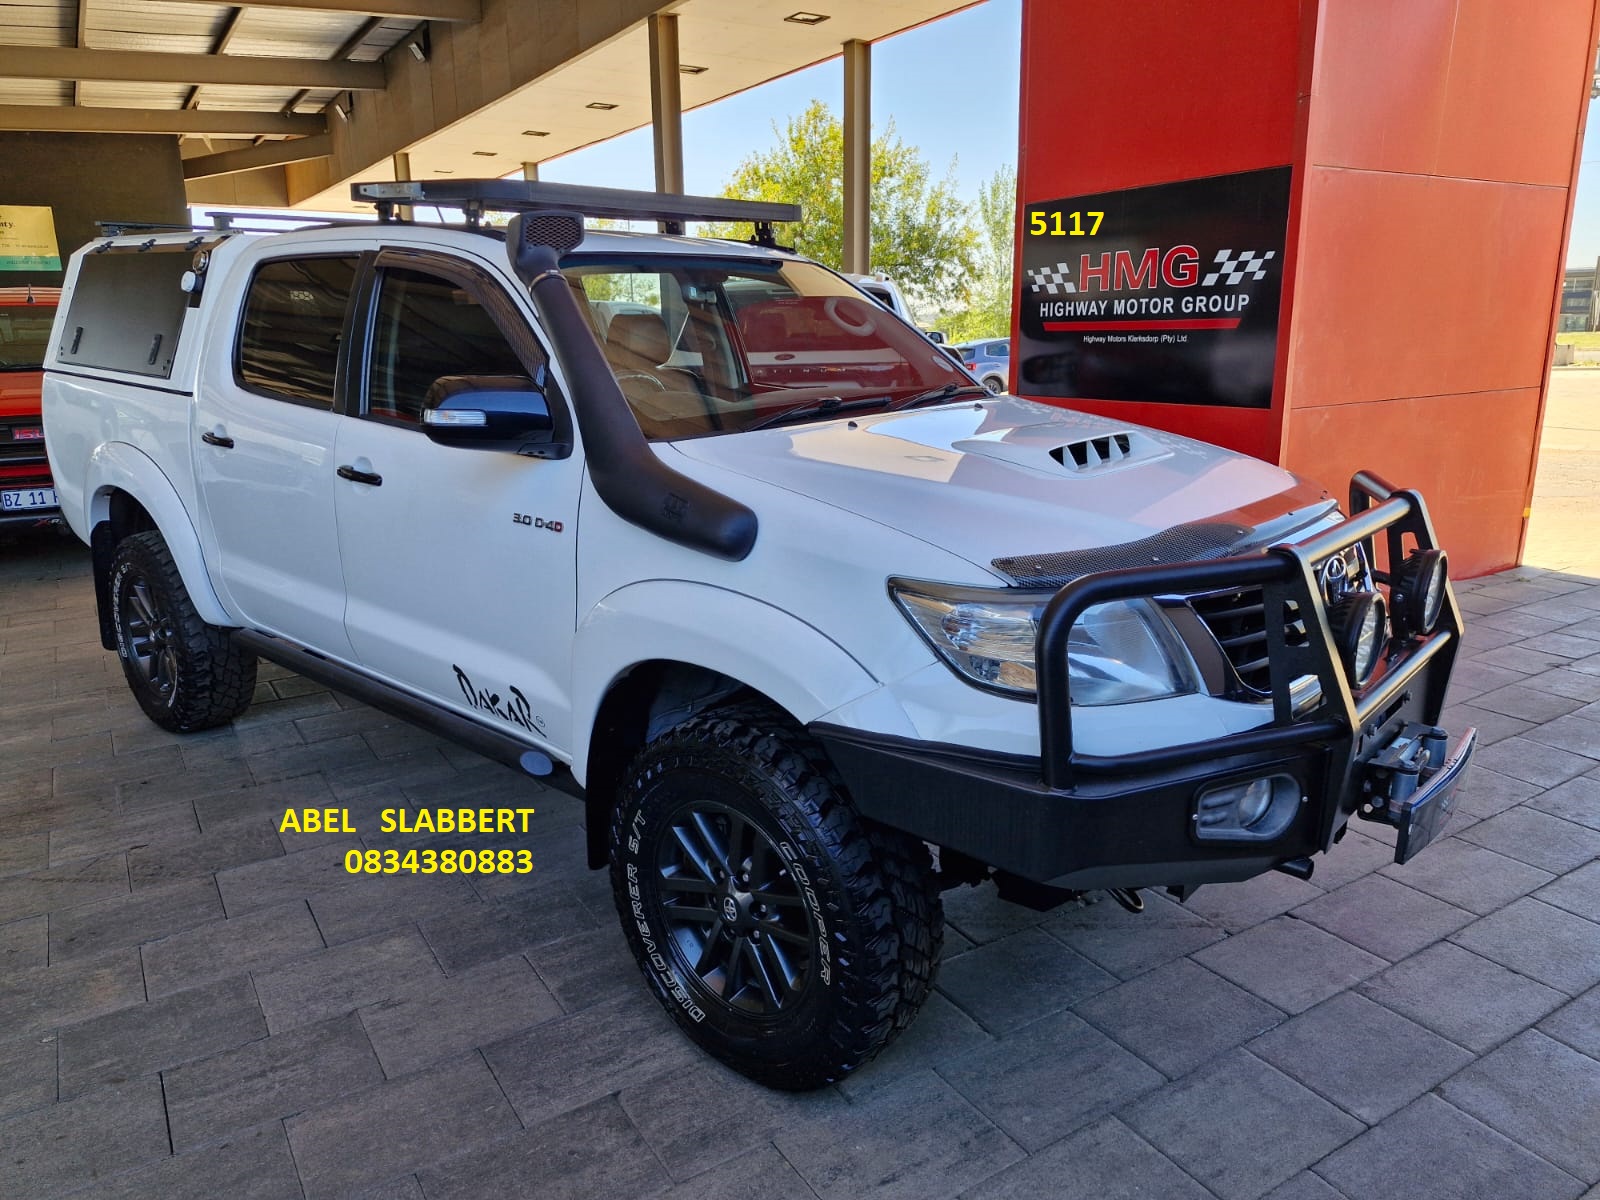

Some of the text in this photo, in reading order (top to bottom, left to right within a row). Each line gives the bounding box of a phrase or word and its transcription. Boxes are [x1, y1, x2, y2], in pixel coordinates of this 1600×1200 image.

[1079, 245, 1200, 293] HMG
[1039, 294, 1250, 318] HIGHWAY MOTOR GROUP
[1083, 335, 1106, 344] Highway
[1107, 335, 1127, 343] Motors
[1160, 334, 1176, 344] (Pty)
[1176, 334, 1188, 343] Ltd
[3, 493, 22, 507] BZ
[29, 491, 46, 506] 11
[626, 809, 706, 1023] DISCOVERER S/T
[780, 841, 832, 986] COOPER
